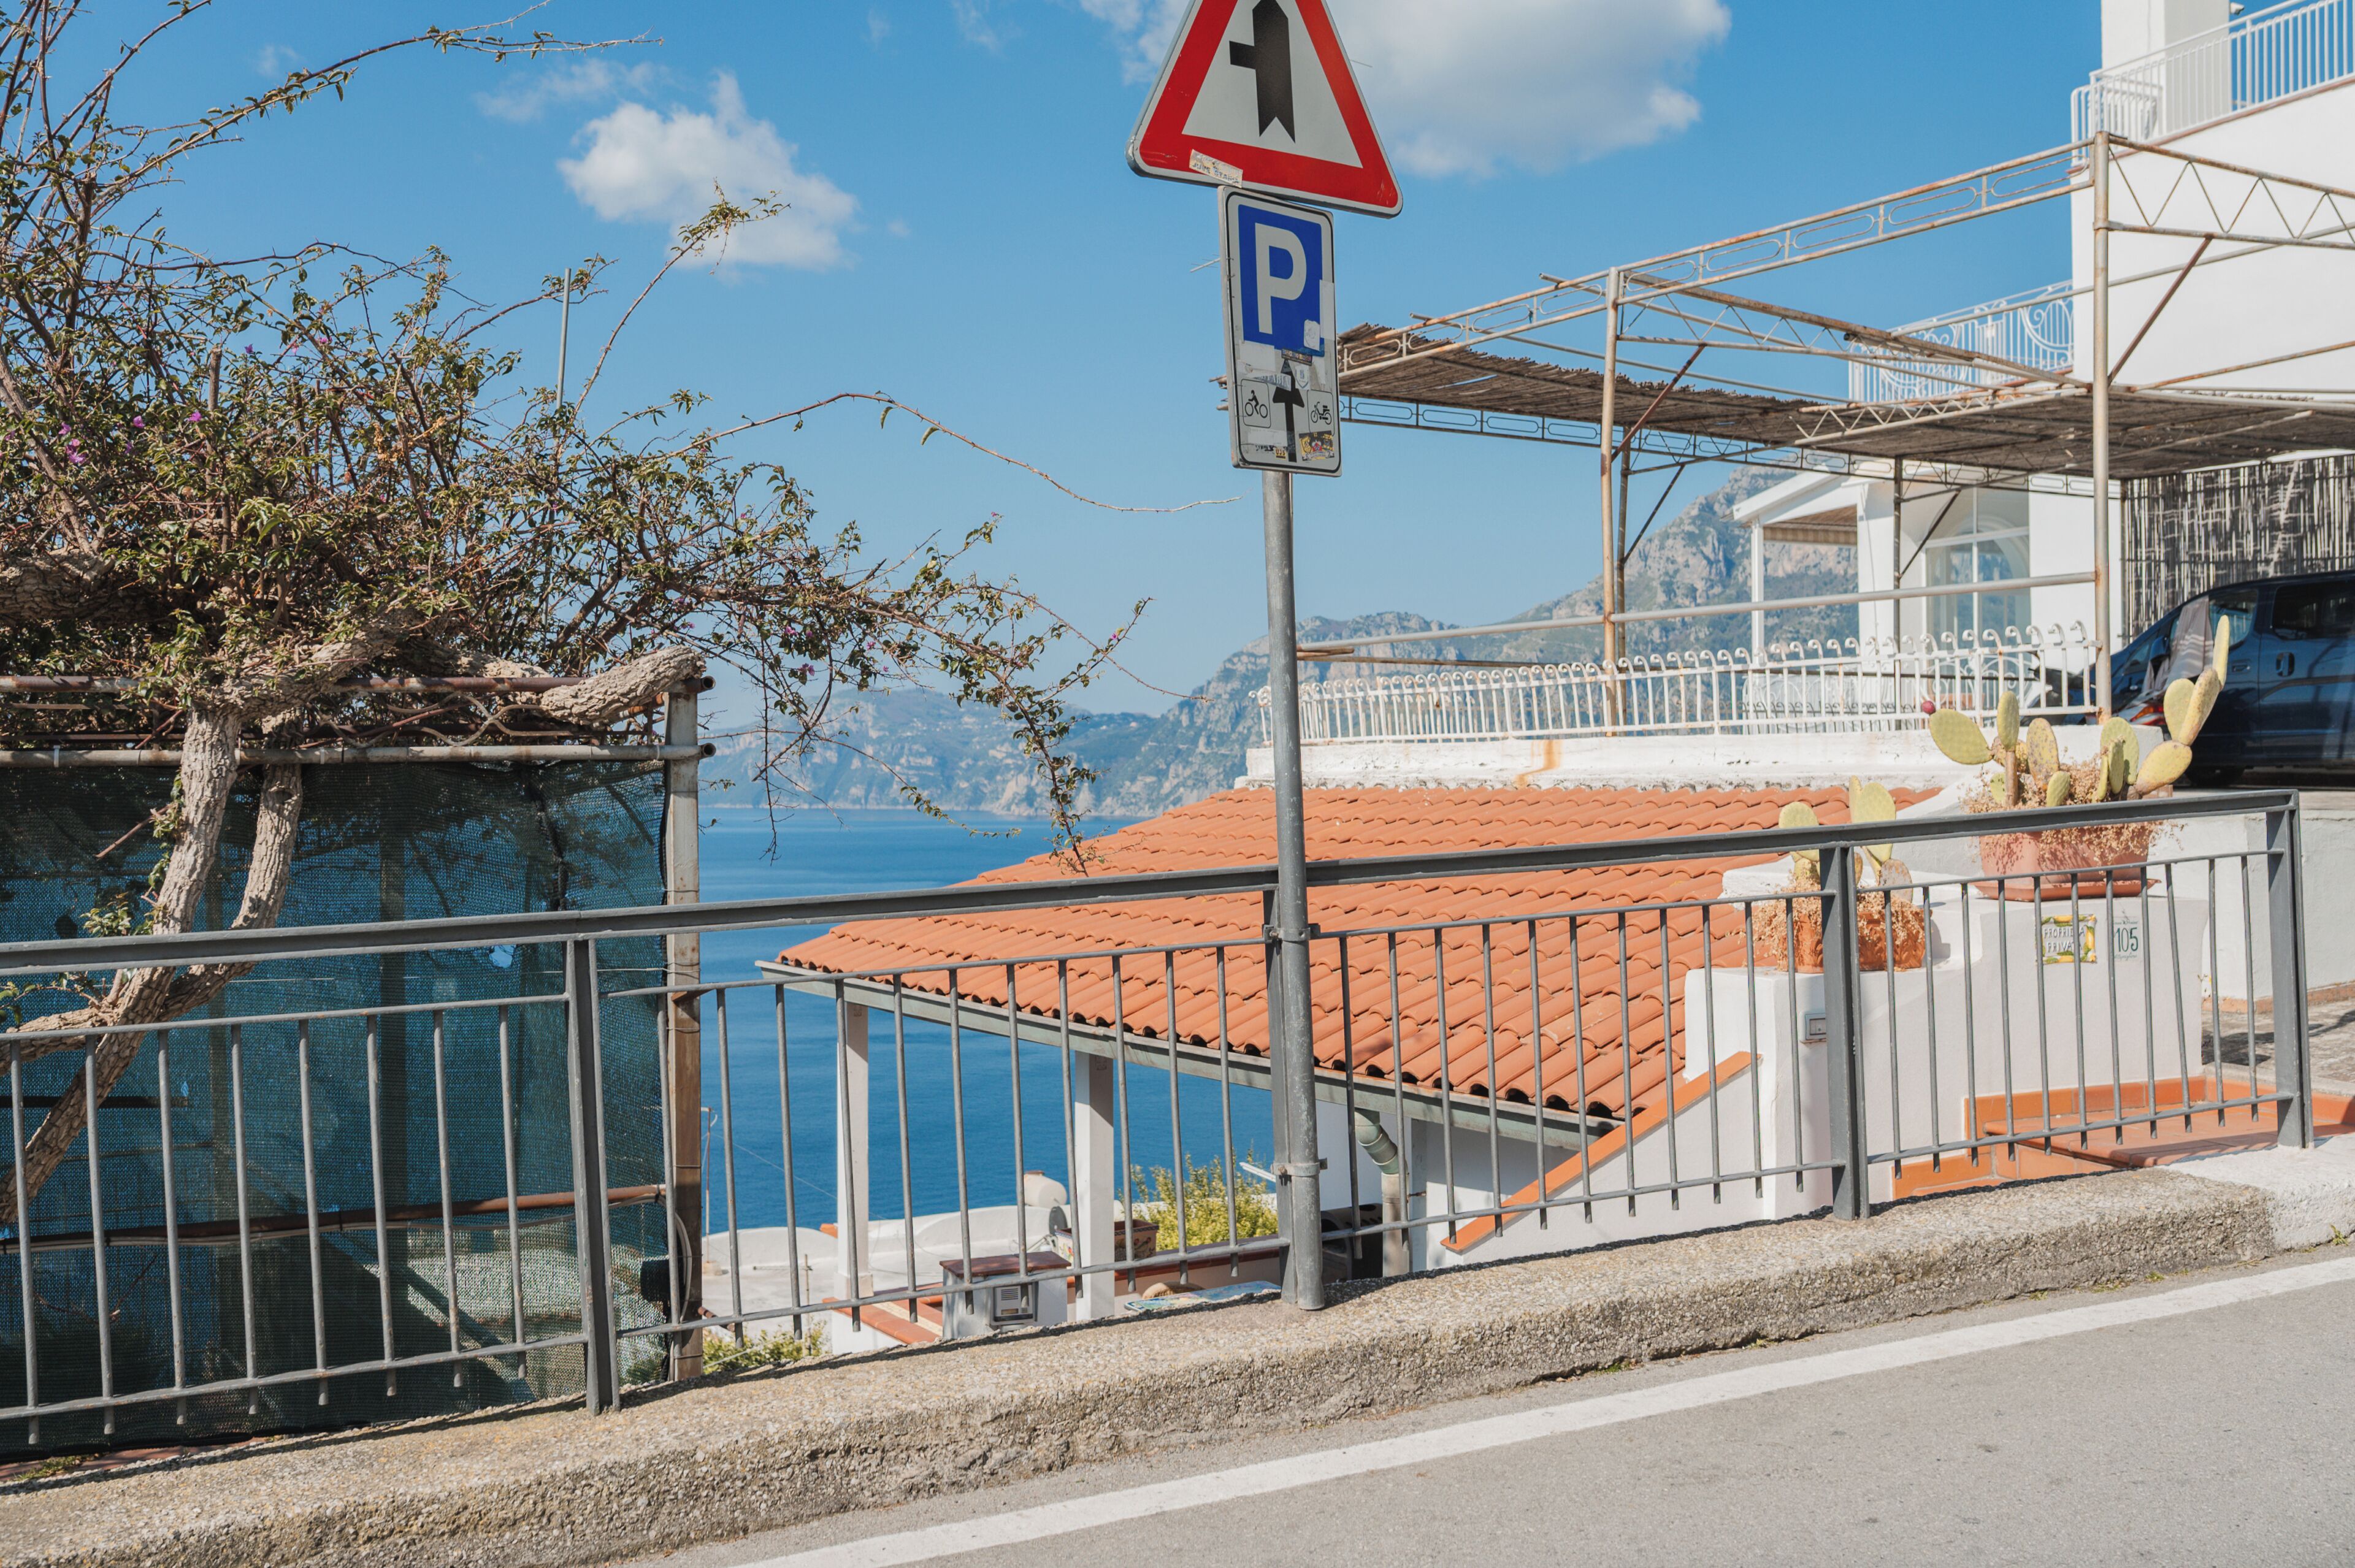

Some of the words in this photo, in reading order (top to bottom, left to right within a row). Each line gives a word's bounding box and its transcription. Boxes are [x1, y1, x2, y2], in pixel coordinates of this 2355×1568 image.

[1255, 223, 1307, 335] P
[2044, 927, 2085, 939] PROPRIEA
[2115, 927, 2139, 952] 105
